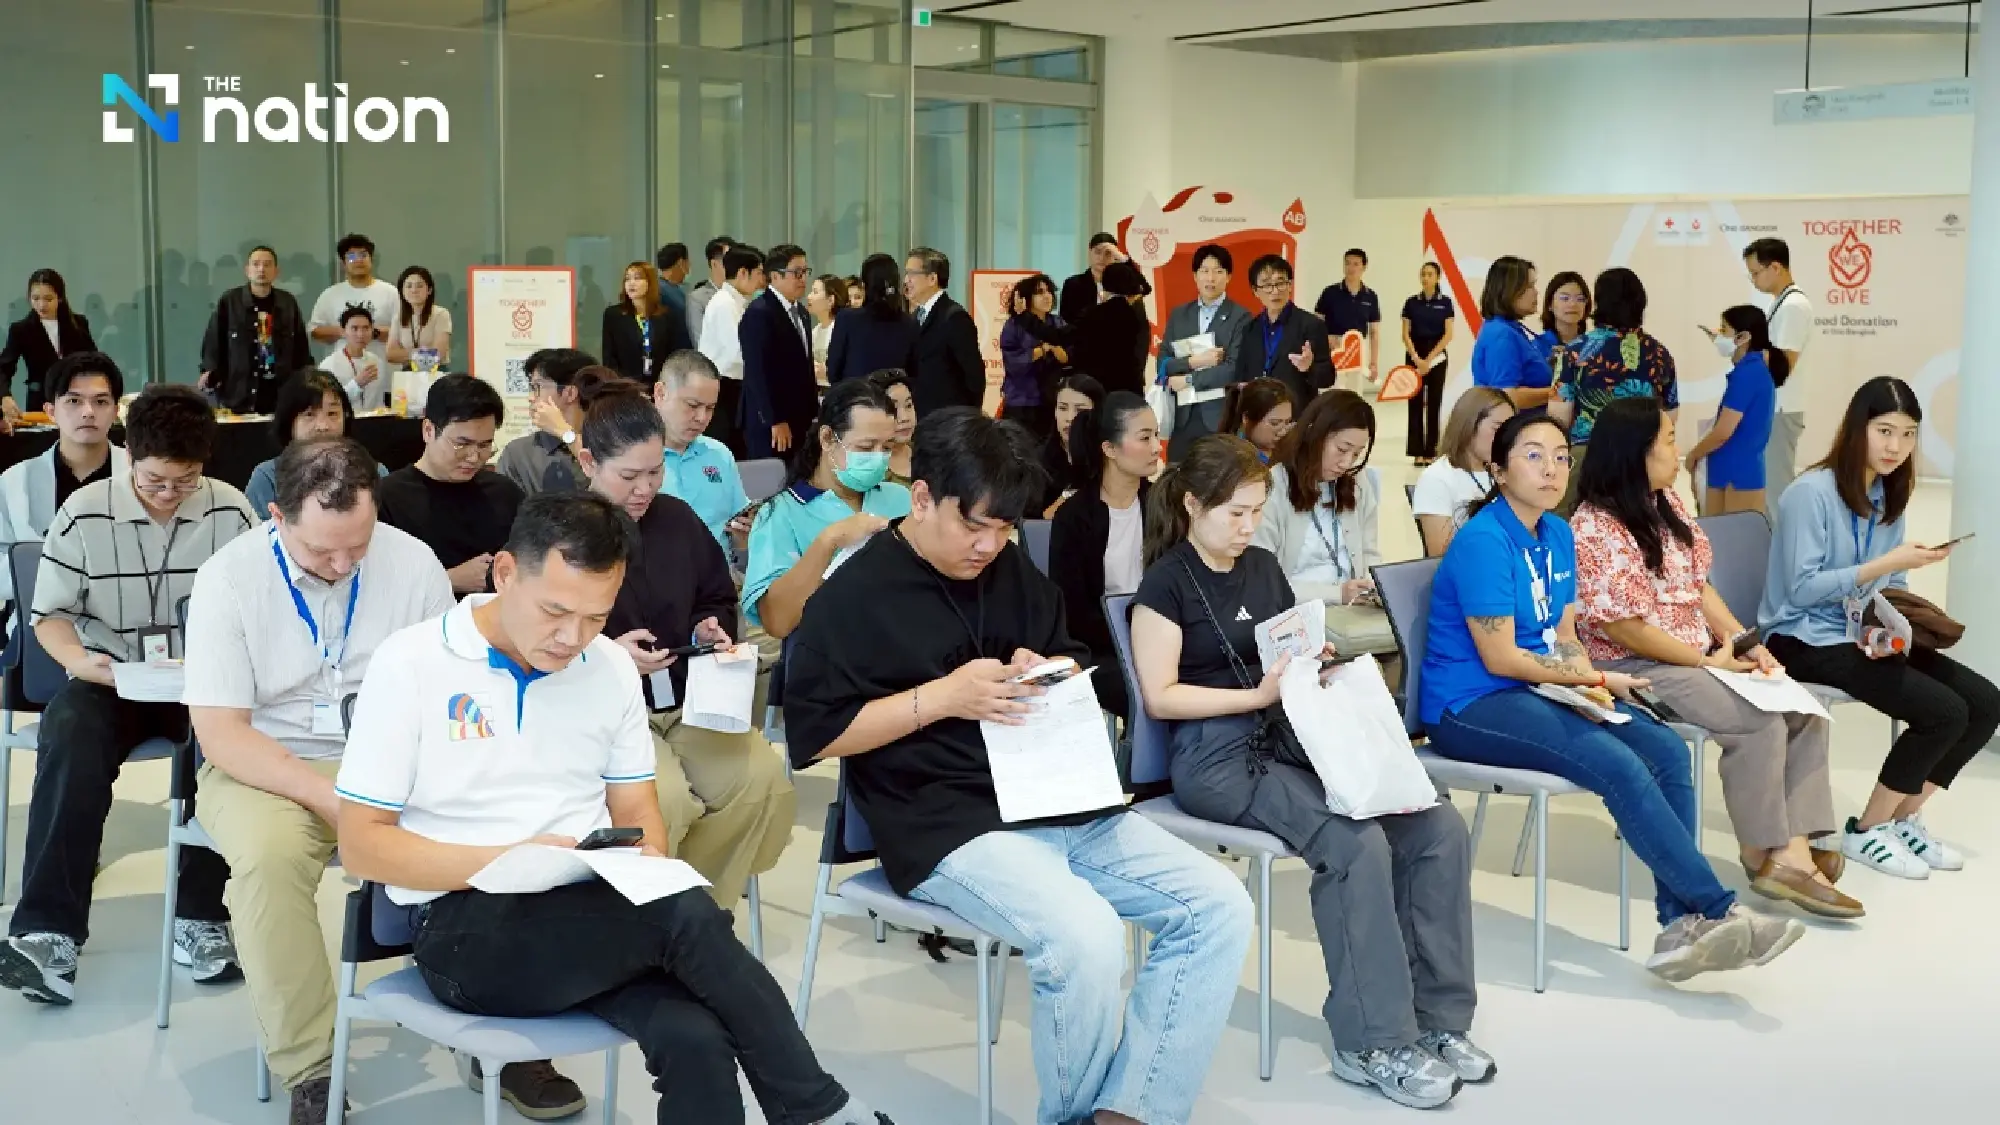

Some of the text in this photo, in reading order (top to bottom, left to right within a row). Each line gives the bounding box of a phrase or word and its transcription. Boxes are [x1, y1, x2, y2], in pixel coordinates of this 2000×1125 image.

[1285, 211, 1304, 225] AB
[1802, 219, 1902, 236] TOGETHER
[1827, 289, 1870, 305] GIVE
[1841, 314, 1898, 327] Donation
